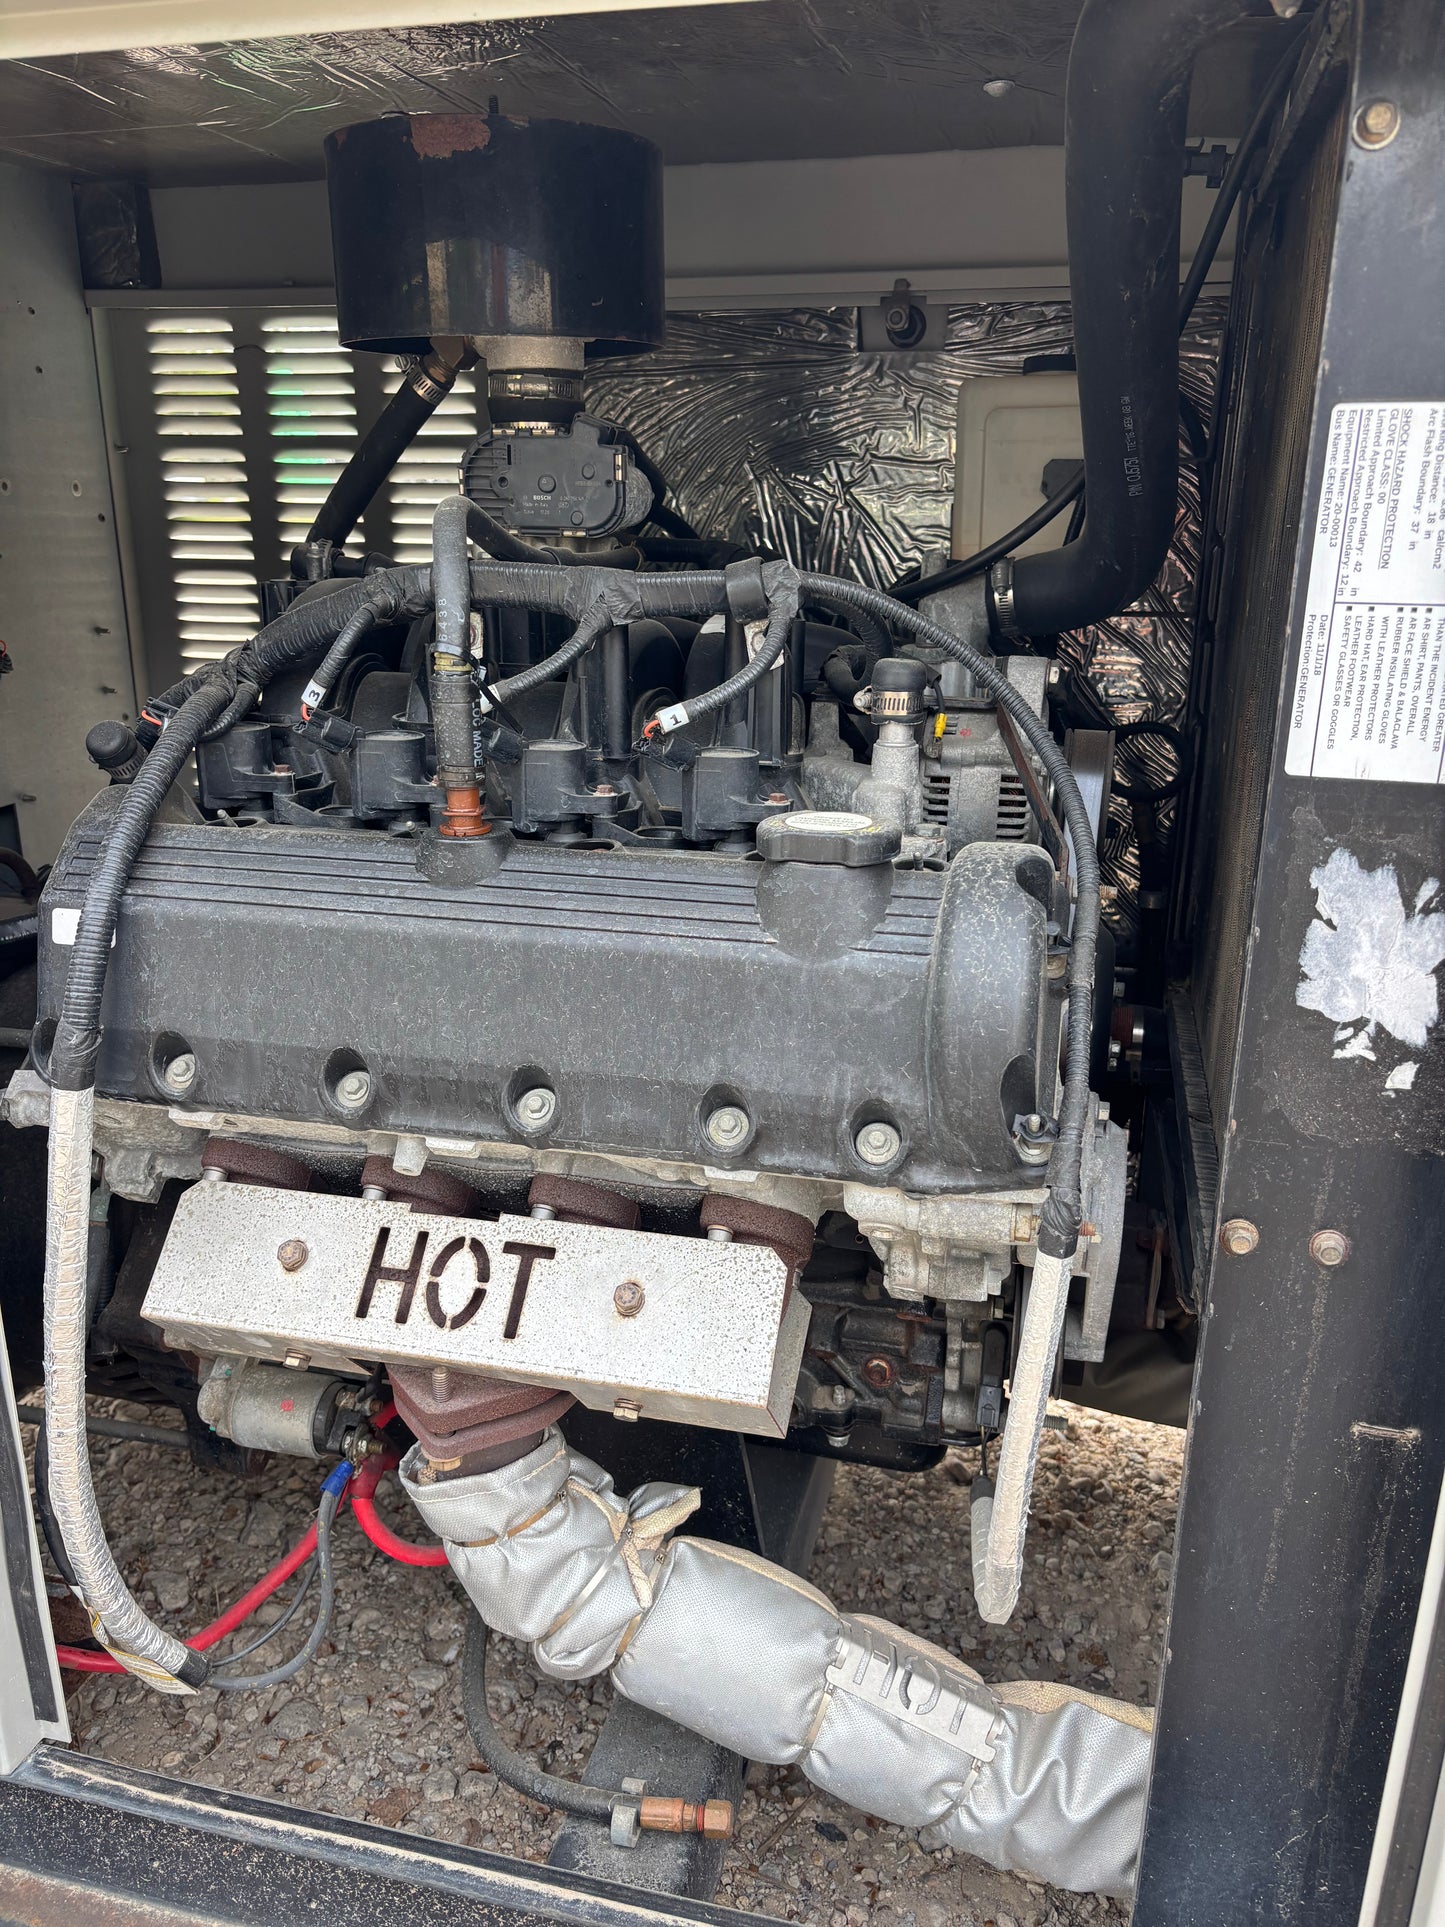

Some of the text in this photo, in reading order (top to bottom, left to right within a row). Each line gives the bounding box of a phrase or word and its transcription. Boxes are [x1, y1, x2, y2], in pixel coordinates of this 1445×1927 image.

[1319, 410, 1344, 534] Bus Name: GENERATOR
[1329, 410, 1357, 547] Equipment Name: 20-00013
[1338, 409, 1374, 596] Restricted Approach Boundary: 12 in
[1350, 409, 1386, 596] Limited Approach Boundary: 42 in
[1377, 409, 1399, 504] GLOVE CLASS: 00
[1381, 409, 1413, 569] SHOCK HAZARD PROTECTION
[1409, 408, 1438, 550] Arc Flash Boundary: 37 in
[1429, 455, 1444, 503] Distance:
[1424, 531, 1433, 539] in
[1427, 512, 1436, 524] 18
[1433, 530, 1445, 569] cal/cm2
[1314, 615, 1328, 676] Date: 11/1/18
[1344, 616, 1362, 707] LEATHER FOOTWEAR
[1405, 632, 1415, 655] FACE
[1409, 618, 1417, 629] AR
[309, 689, 320, 702] 3
[670, 714, 682, 726] 1
[1327, 616, 1352, 749] SAFETY GLASSES OR GOGGLES
[1350, 616, 1375, 740] HARD HAT, EAR PROTECTION,
[1365, 616, 1390, 740] WITH LEATHER PROTECTORS
[1378, 617, 1404, 744] RUBBER INSULATING GLOVES
[1400, 658, 1410, 689] SHIELD
[1406, 618, 1431, 735] AR SHIRT, PANTS, OVERALL
[1419, 619, 1444, 742] THAN THE INCIDENT ENERGY
[472, 730, 484, 768] MADE
[1390, 700, 1404, 749] BALACLAVA
[1432, 712, 1445, 752] GREATER
[355, 1226, 557, 1340] HOT
[853, 1629, 978, 1735] HOT
